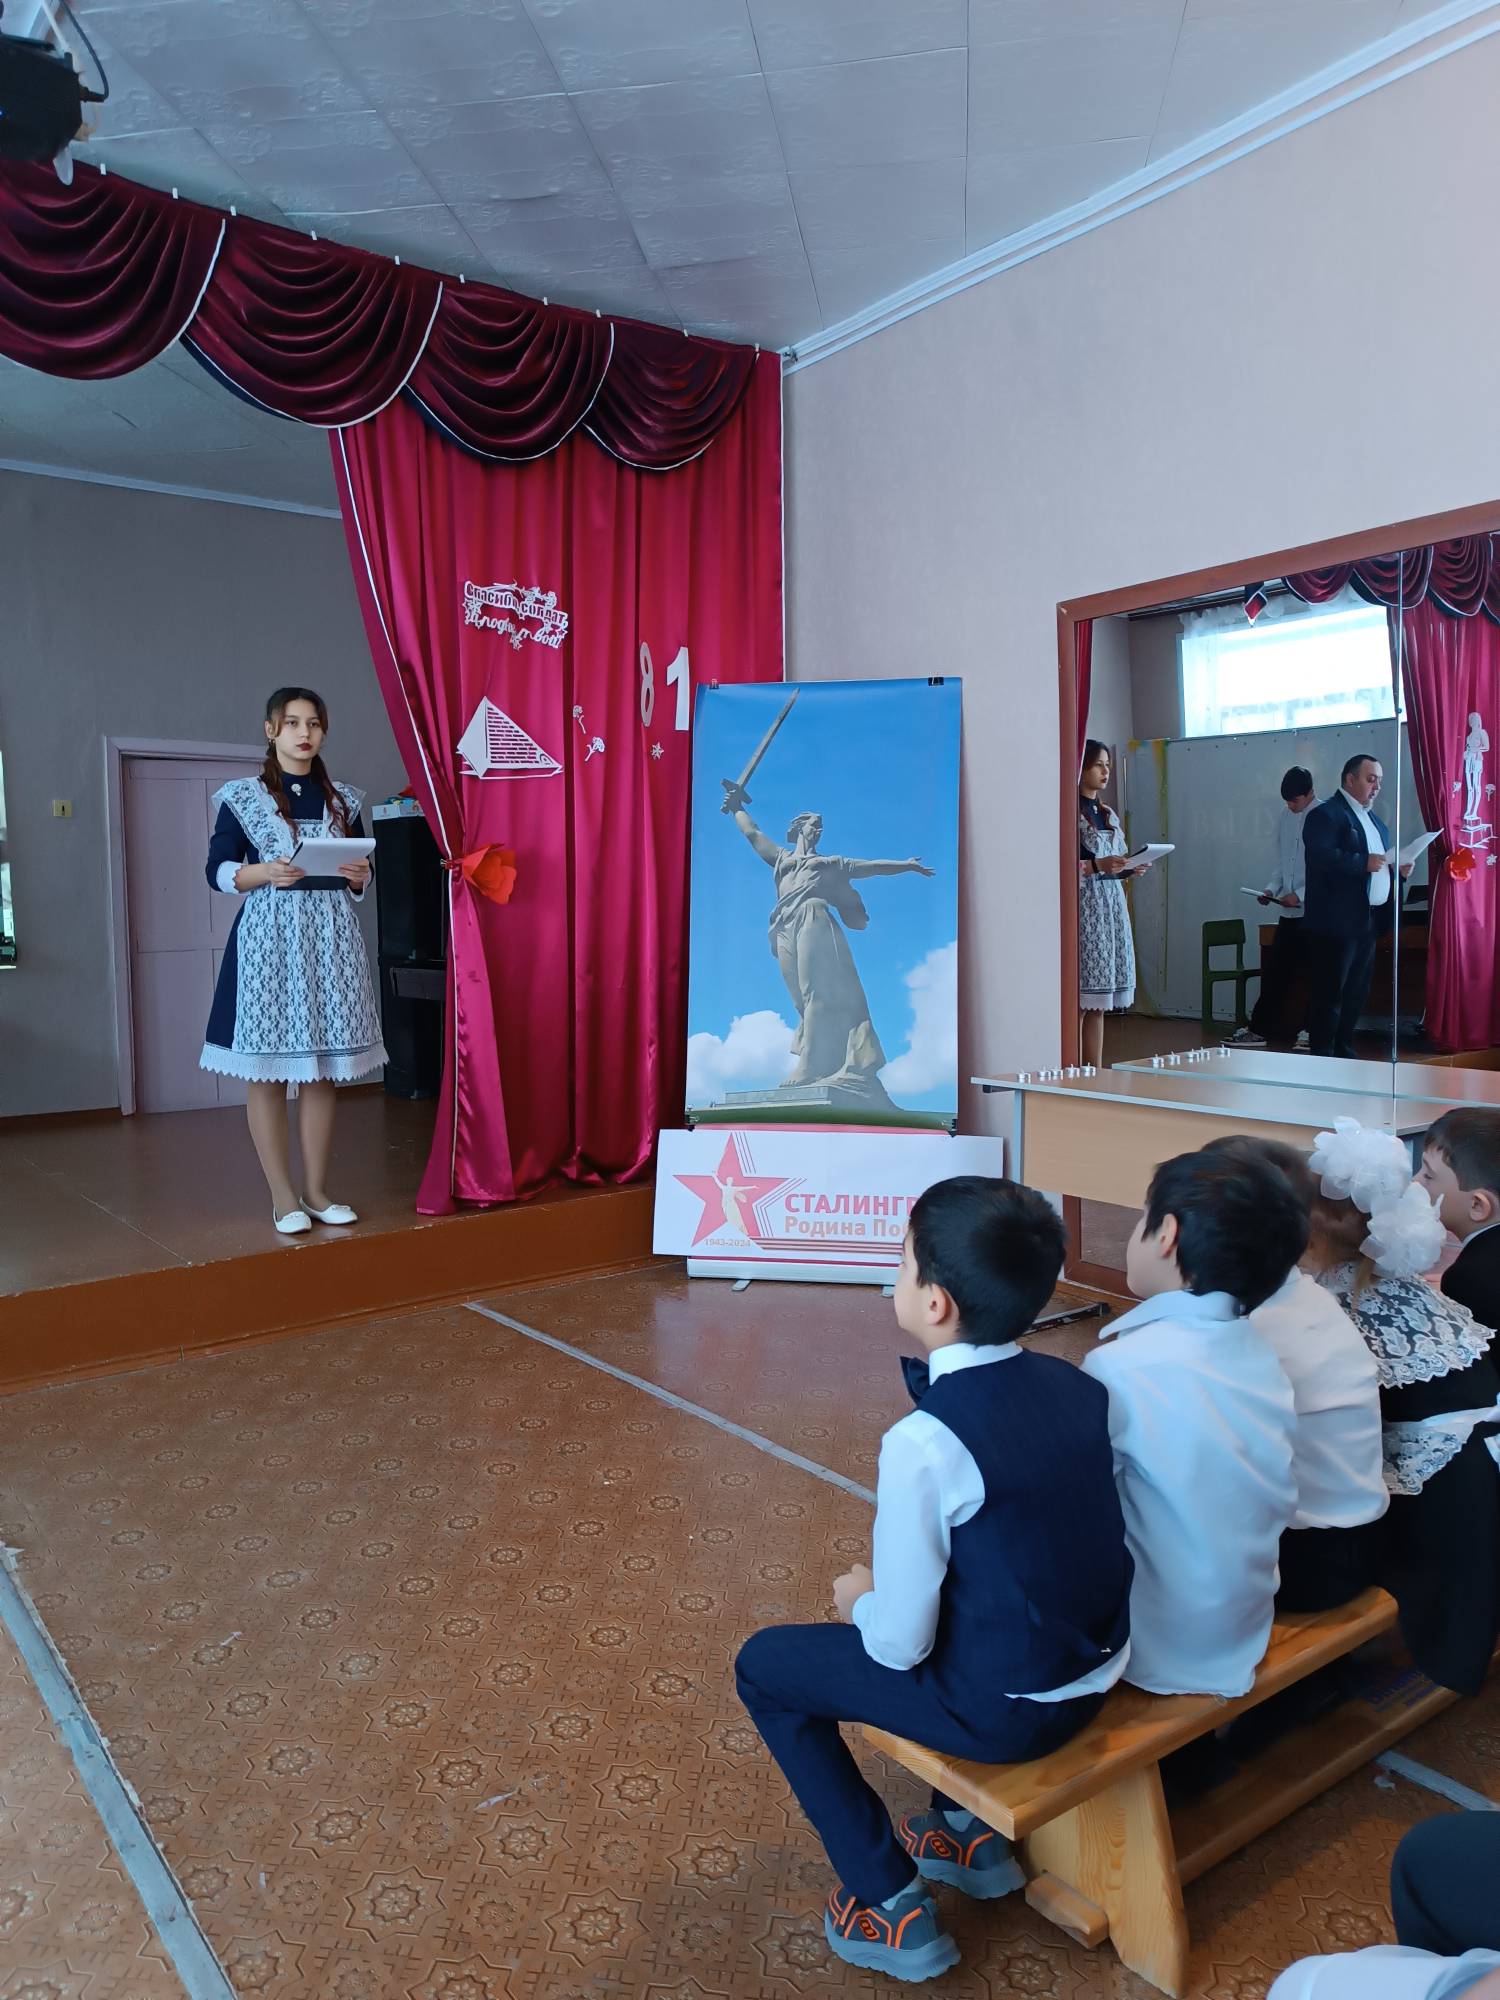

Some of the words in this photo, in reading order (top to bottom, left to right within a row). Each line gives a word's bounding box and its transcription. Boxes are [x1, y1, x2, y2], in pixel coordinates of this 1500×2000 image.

[638, 641, 690, 731] 81
[785, 1215, 866, 1237] Родина
[873, 1218, 908, 1237] По
